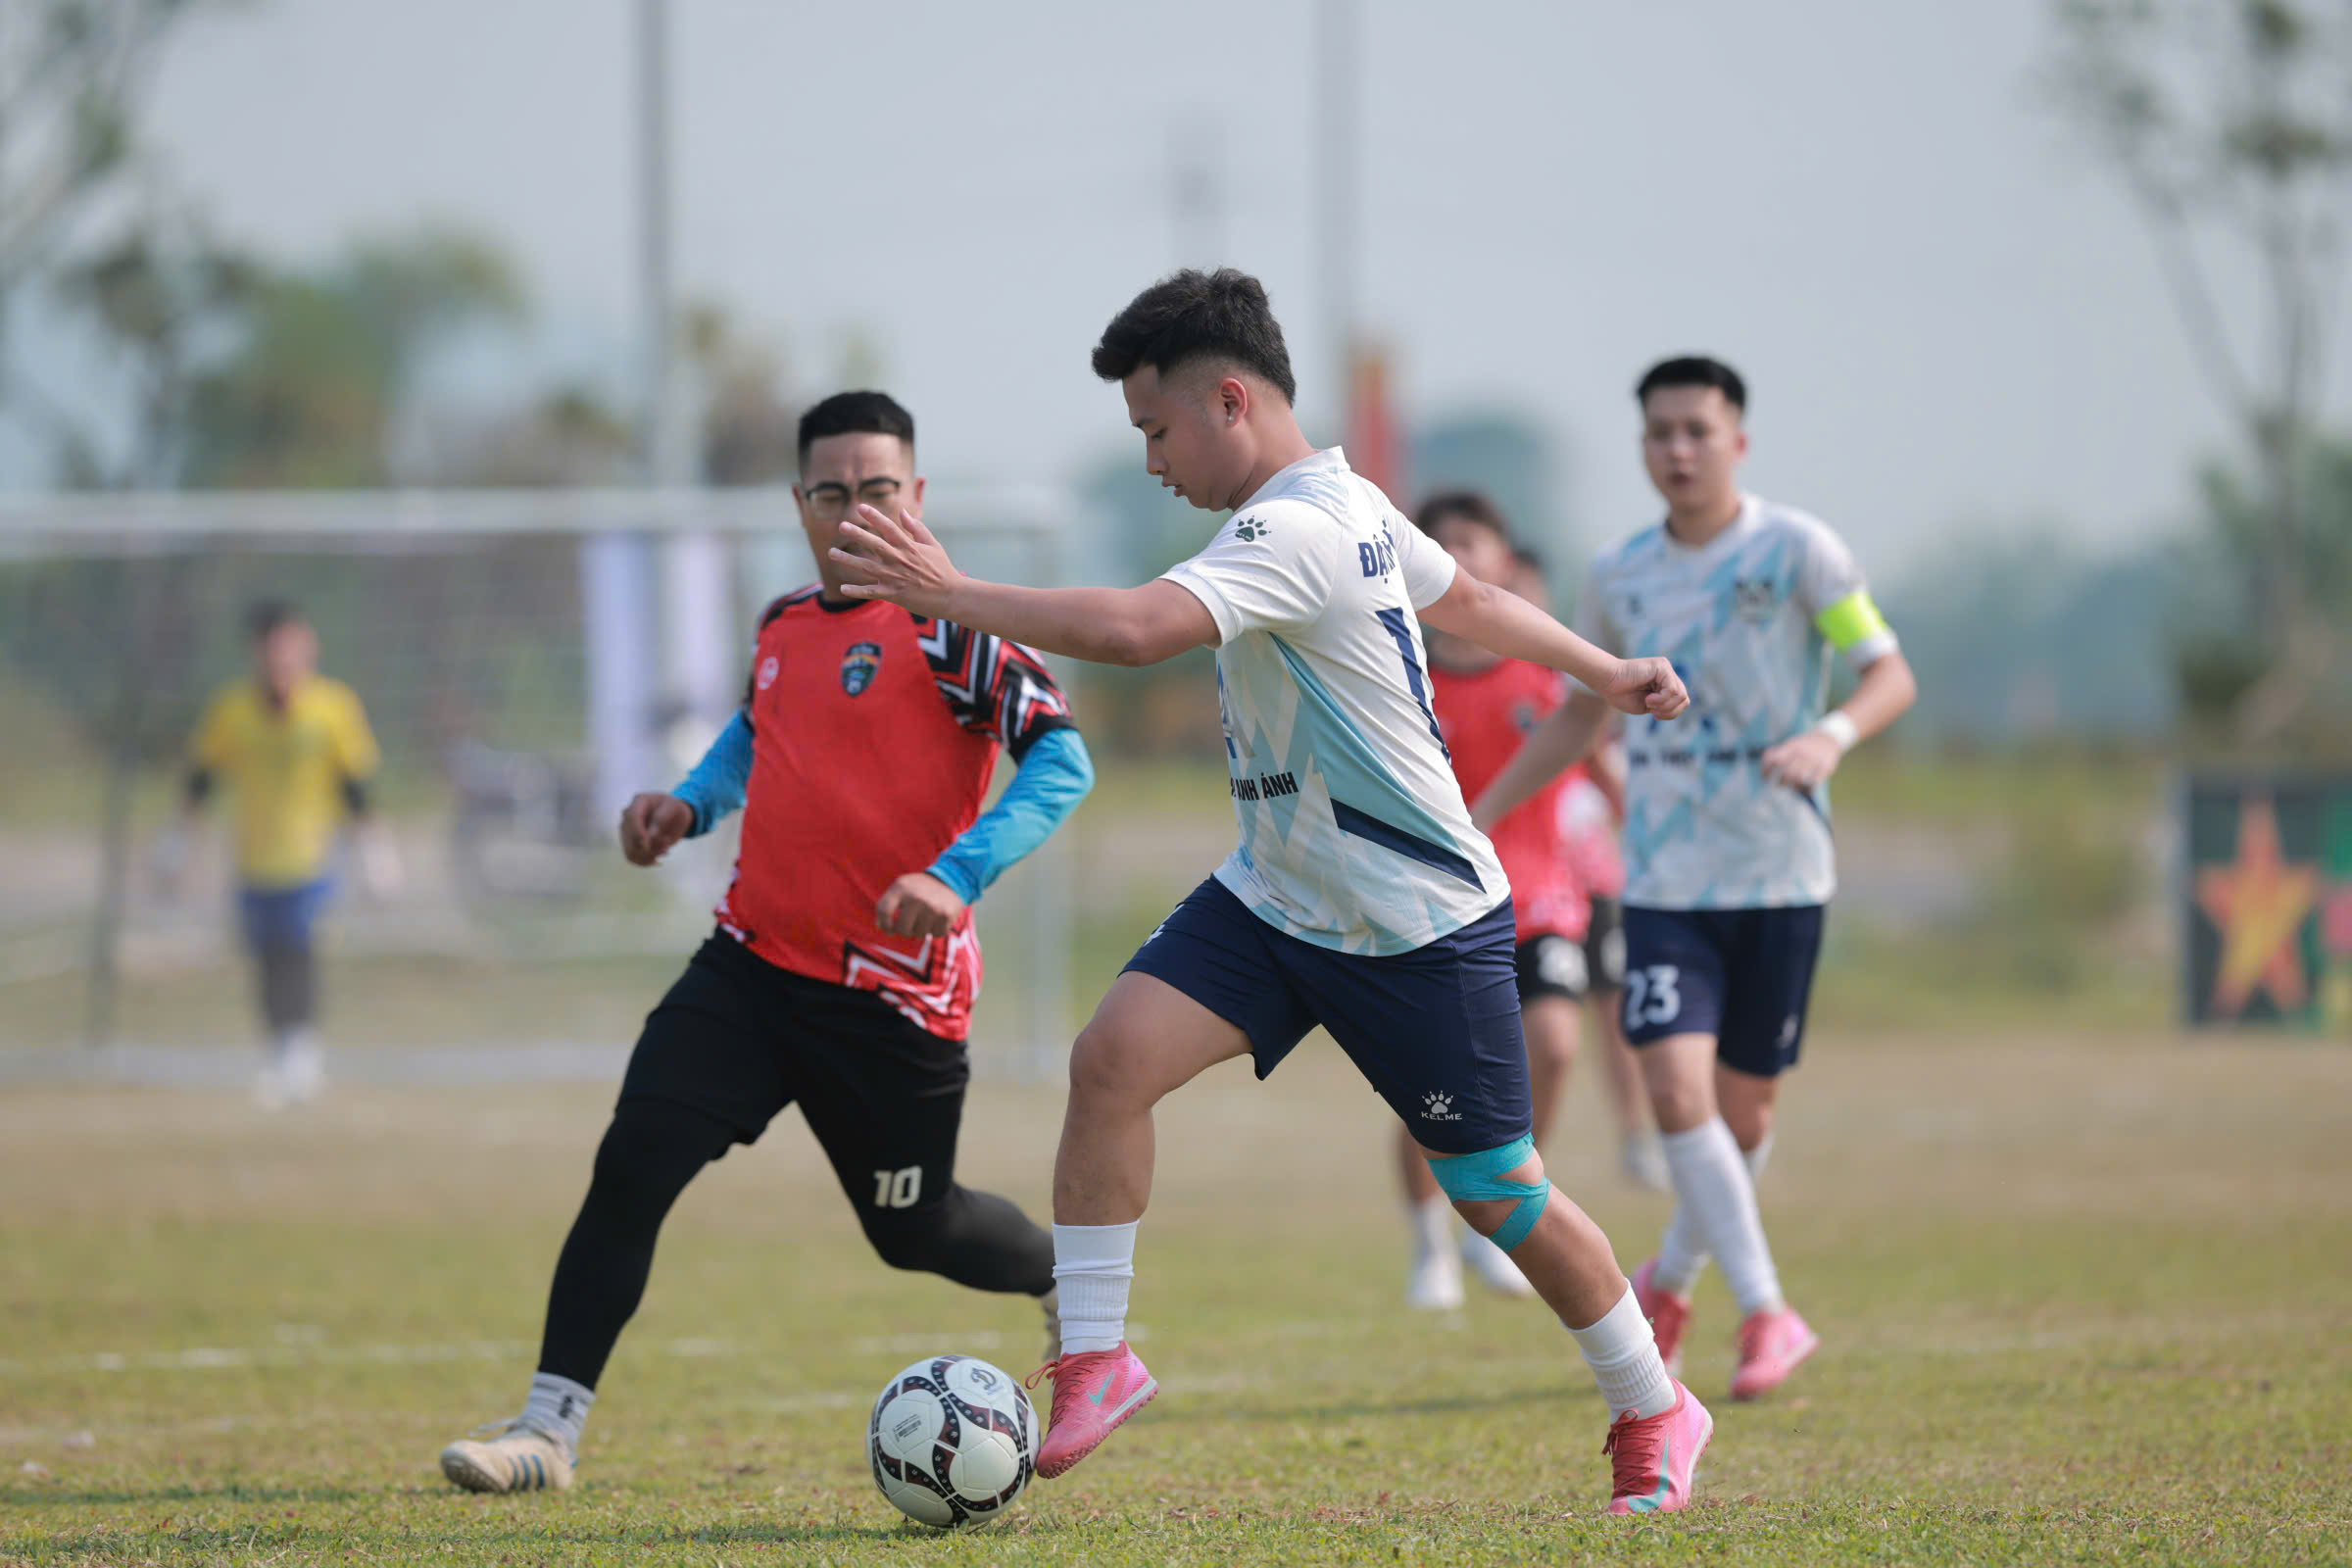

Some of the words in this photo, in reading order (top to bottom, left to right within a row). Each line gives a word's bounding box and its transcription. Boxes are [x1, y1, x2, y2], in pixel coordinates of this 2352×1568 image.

[1626, 964, 1681, 1030] 23
[1420, 1111, 1463, 1121] KELME
[873, 1164, 923, 1208] 10
